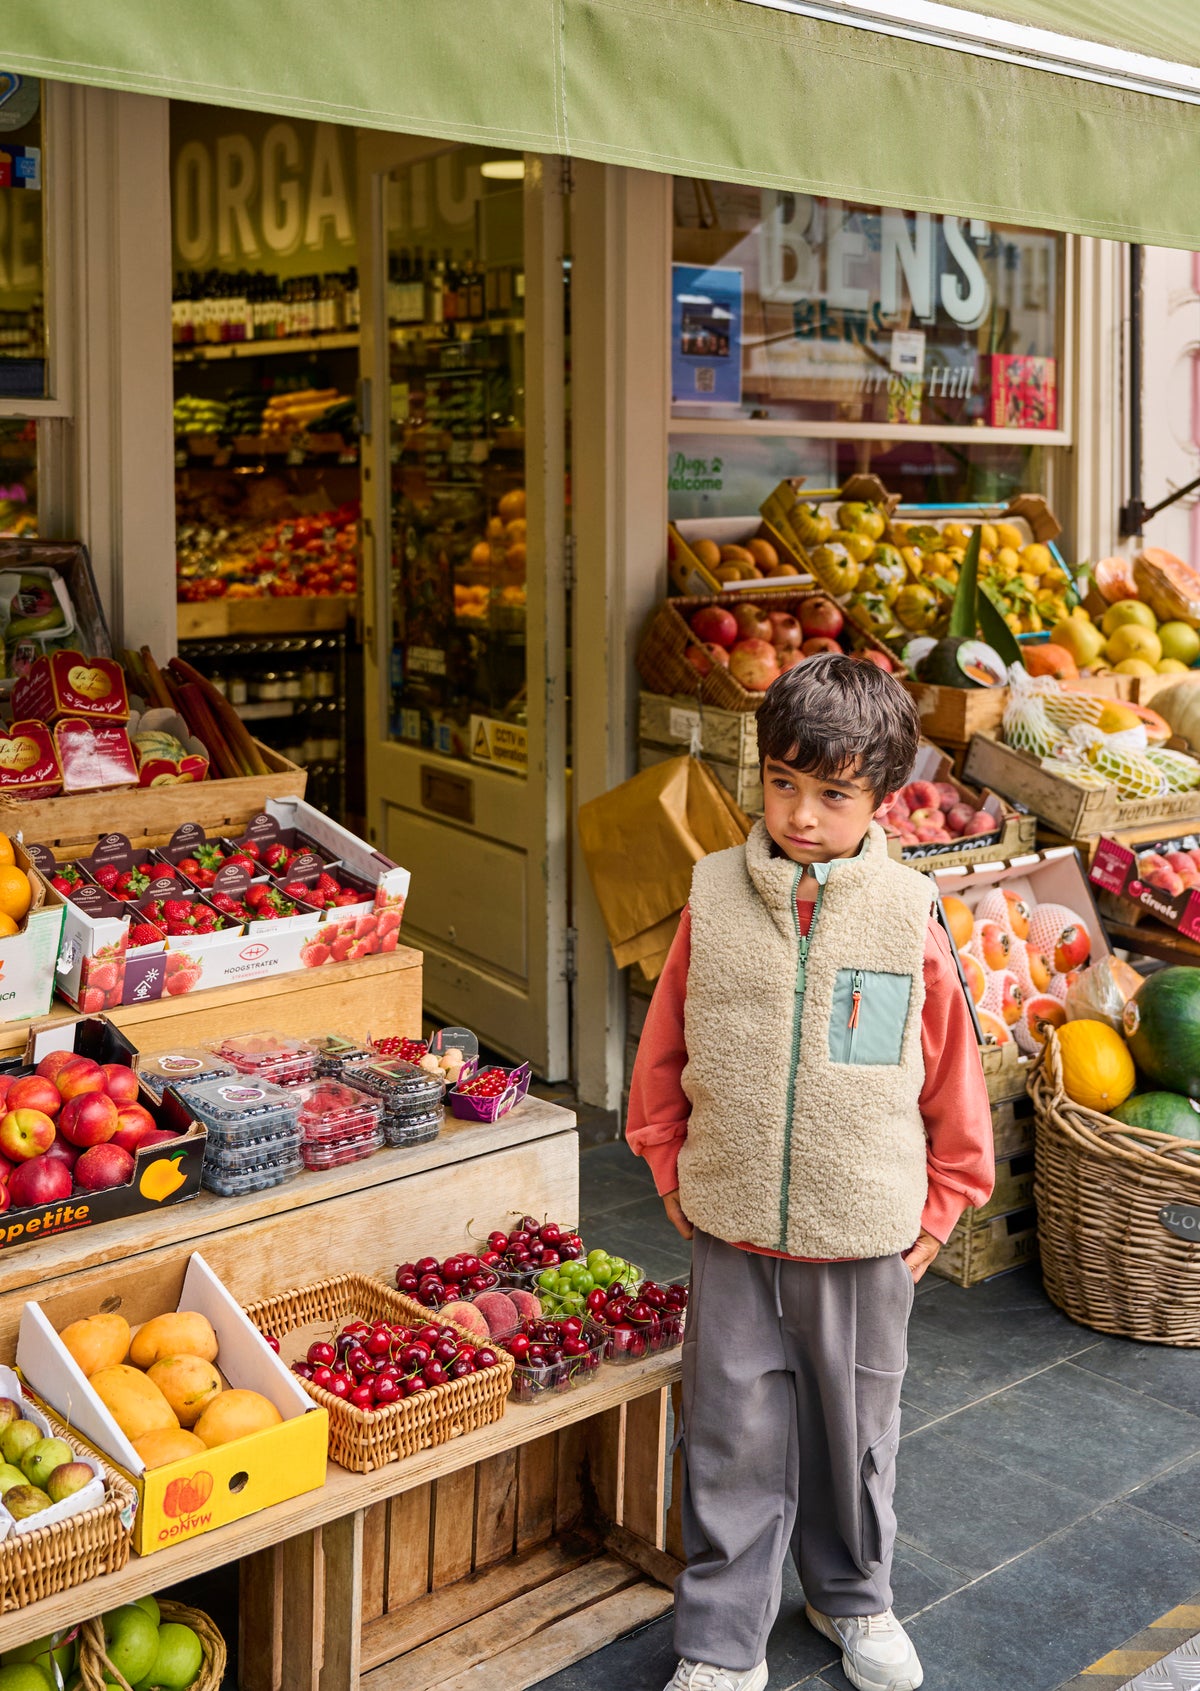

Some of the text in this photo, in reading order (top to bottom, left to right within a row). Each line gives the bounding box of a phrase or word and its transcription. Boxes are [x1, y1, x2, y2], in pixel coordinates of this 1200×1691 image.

[760, 189, 991, 330] BENS
[928, 365, 976, 400] Hill
[673, 452, 707, 477] Dogs
[668, 475, 723, 491] elcome
[496, 727, 516, 747] CCTV
[224, 958, 279, 975] HOOGSTRATEN
[158, 1511, 213, 1541] MANGO
